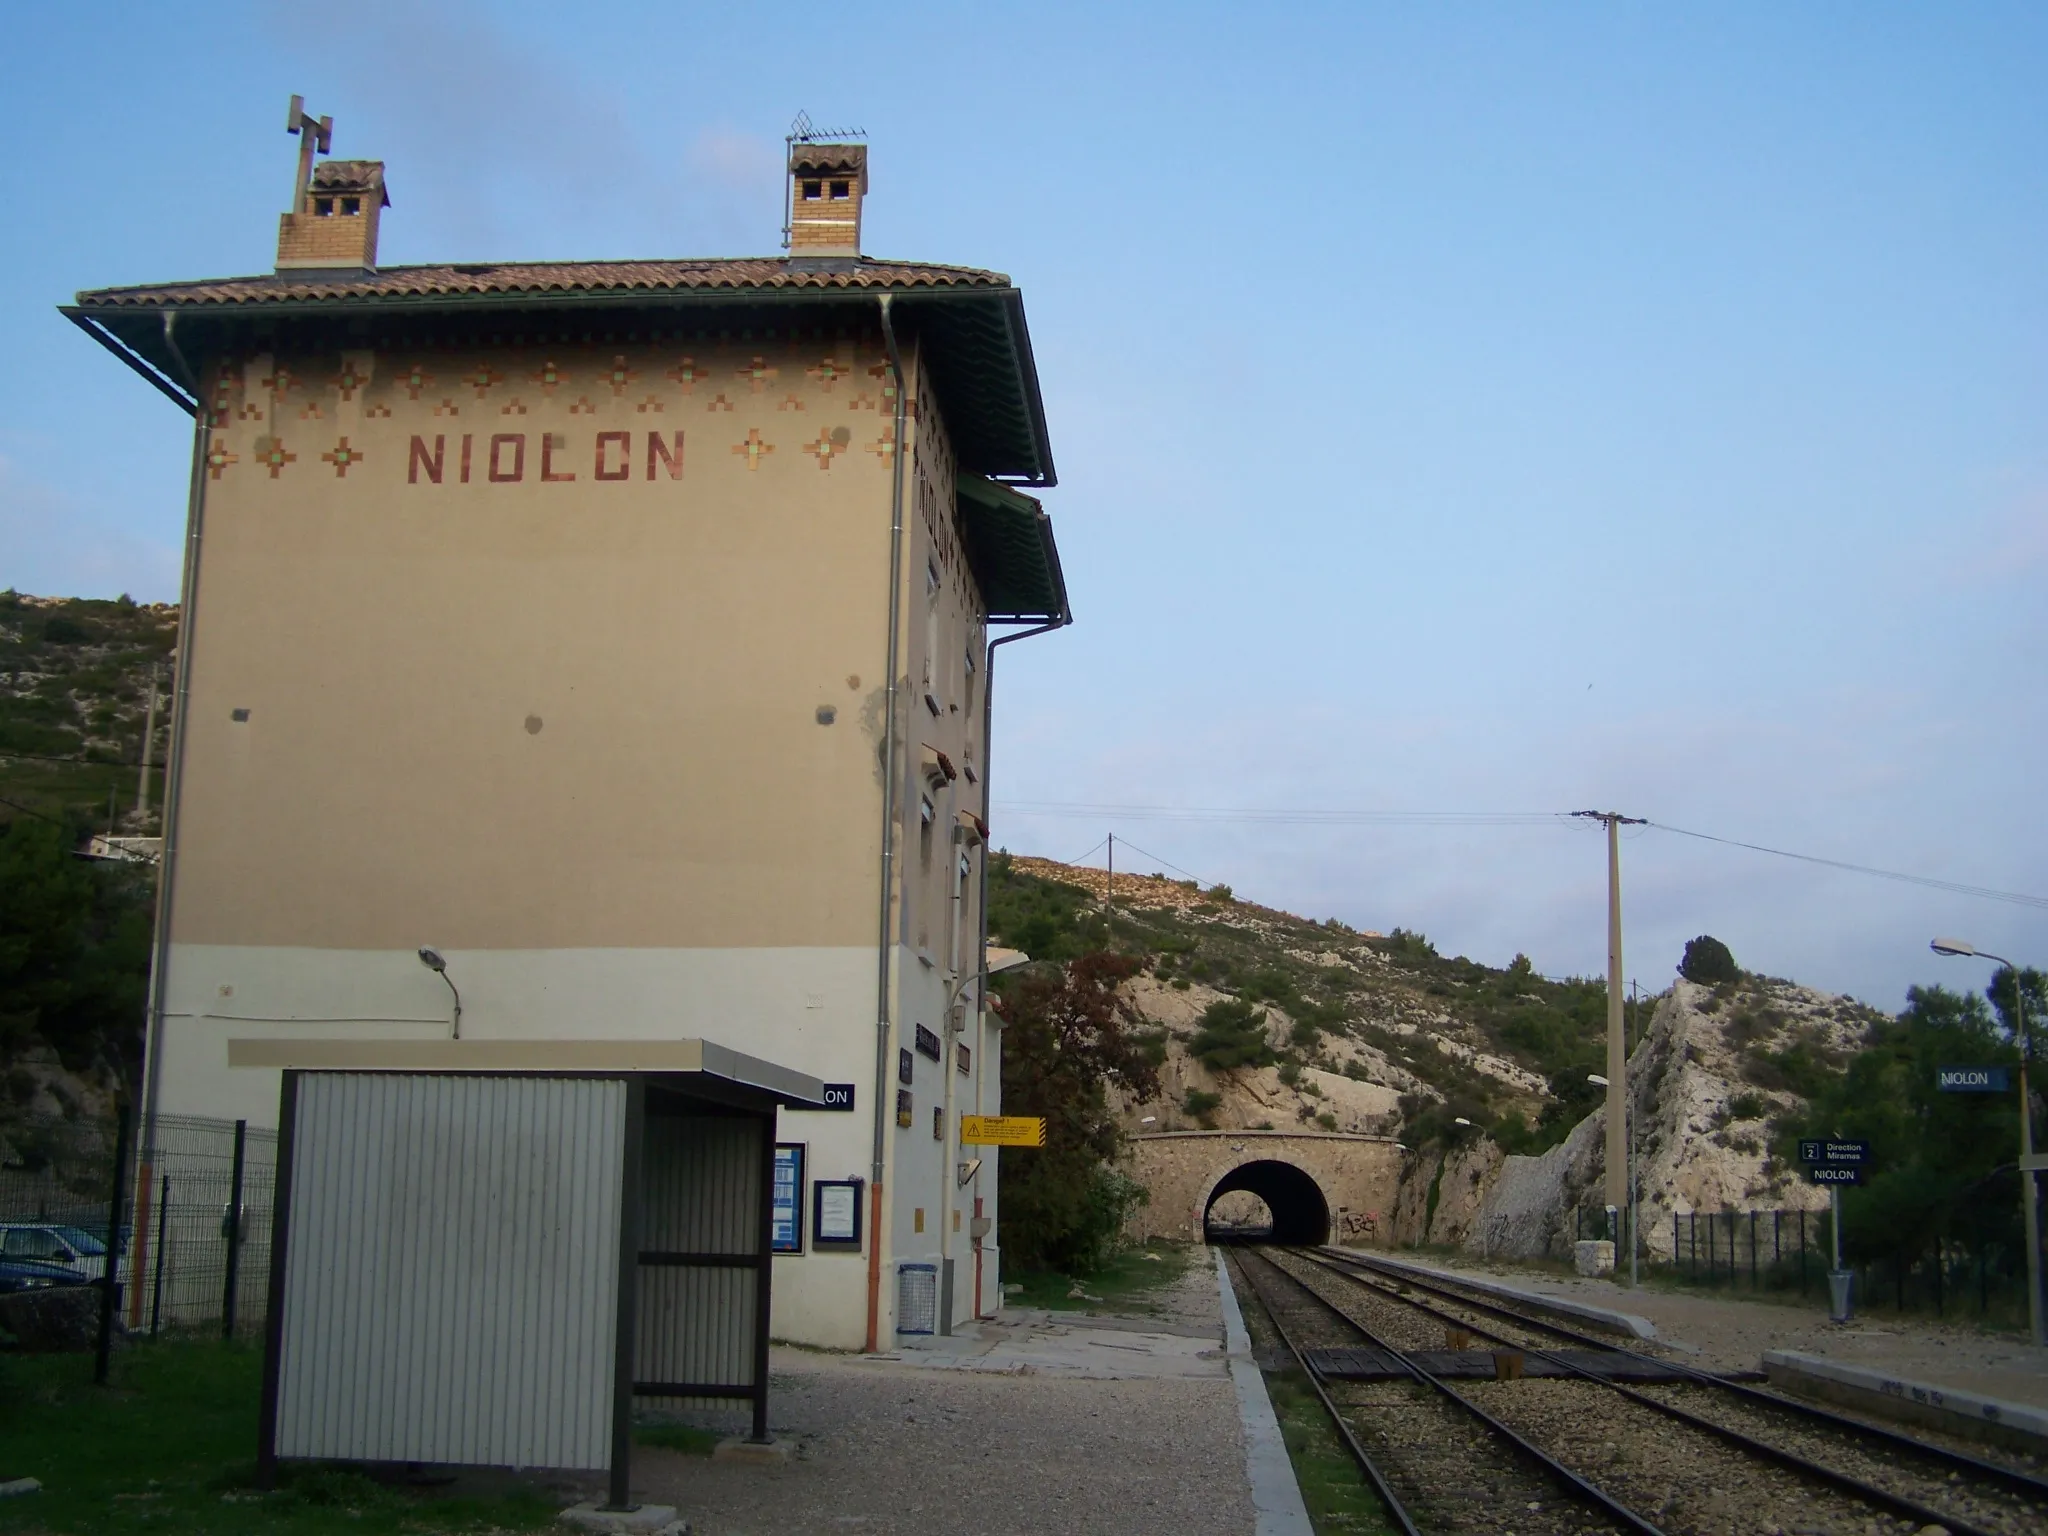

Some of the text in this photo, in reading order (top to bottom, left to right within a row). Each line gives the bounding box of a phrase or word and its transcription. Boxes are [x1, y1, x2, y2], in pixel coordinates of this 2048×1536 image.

[408, 431, 685, 484] NIOLON
[1941, 1072, 1988, 1085] NIOLON
[1826, 1143, 1862, 1151] Direction
[1807, 1149, 1814, 1158] 2
[1827, 1152, 1861, 1160] Miramas
[1814, 1170, 1855, 1180] NIOLON
